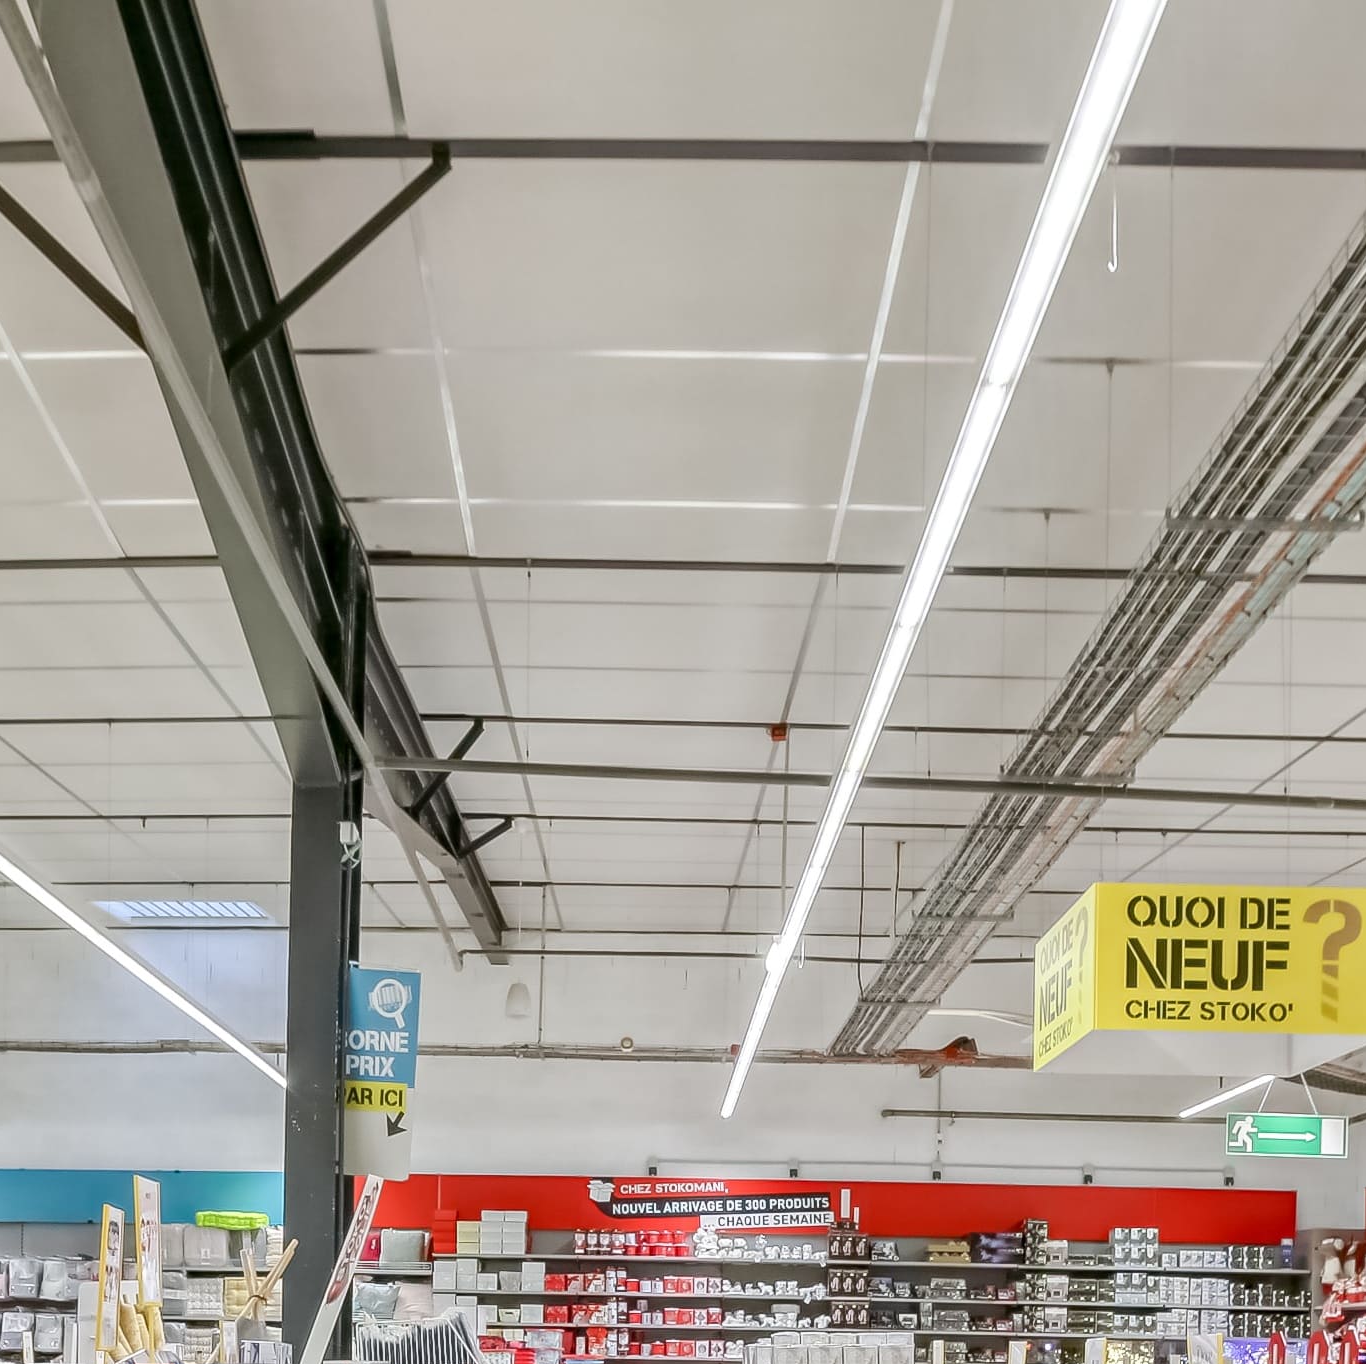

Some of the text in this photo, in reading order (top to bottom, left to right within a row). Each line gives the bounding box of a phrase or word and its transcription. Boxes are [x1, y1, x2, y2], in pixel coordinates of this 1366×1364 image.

[1127, 895, 1225, 929] QUOI
[1240, 897, 1291, 930] DE
[1039, 921, 1074, 974] QUOI DE
[1125, 937, 1290, 992] NEUF
[1038, 959, 1073, 1033] NEUF
[1125, 1000, 1293, 1022] CHEZ STOKO'
[345, 1030, 409, 1053] ORNE
[346, 1054, 395, 1078] PRIX
[380, 1088, 403, 1108] ICI
[620, 1182, 729, 1195] CHEZ STOKOMANI,
[612, 1196, 829, 1215] NOUVEL ARRIVAGE DE 300 PRODUITS
[717, 1213, 830, 1228] CHAQUE SEMAINE
